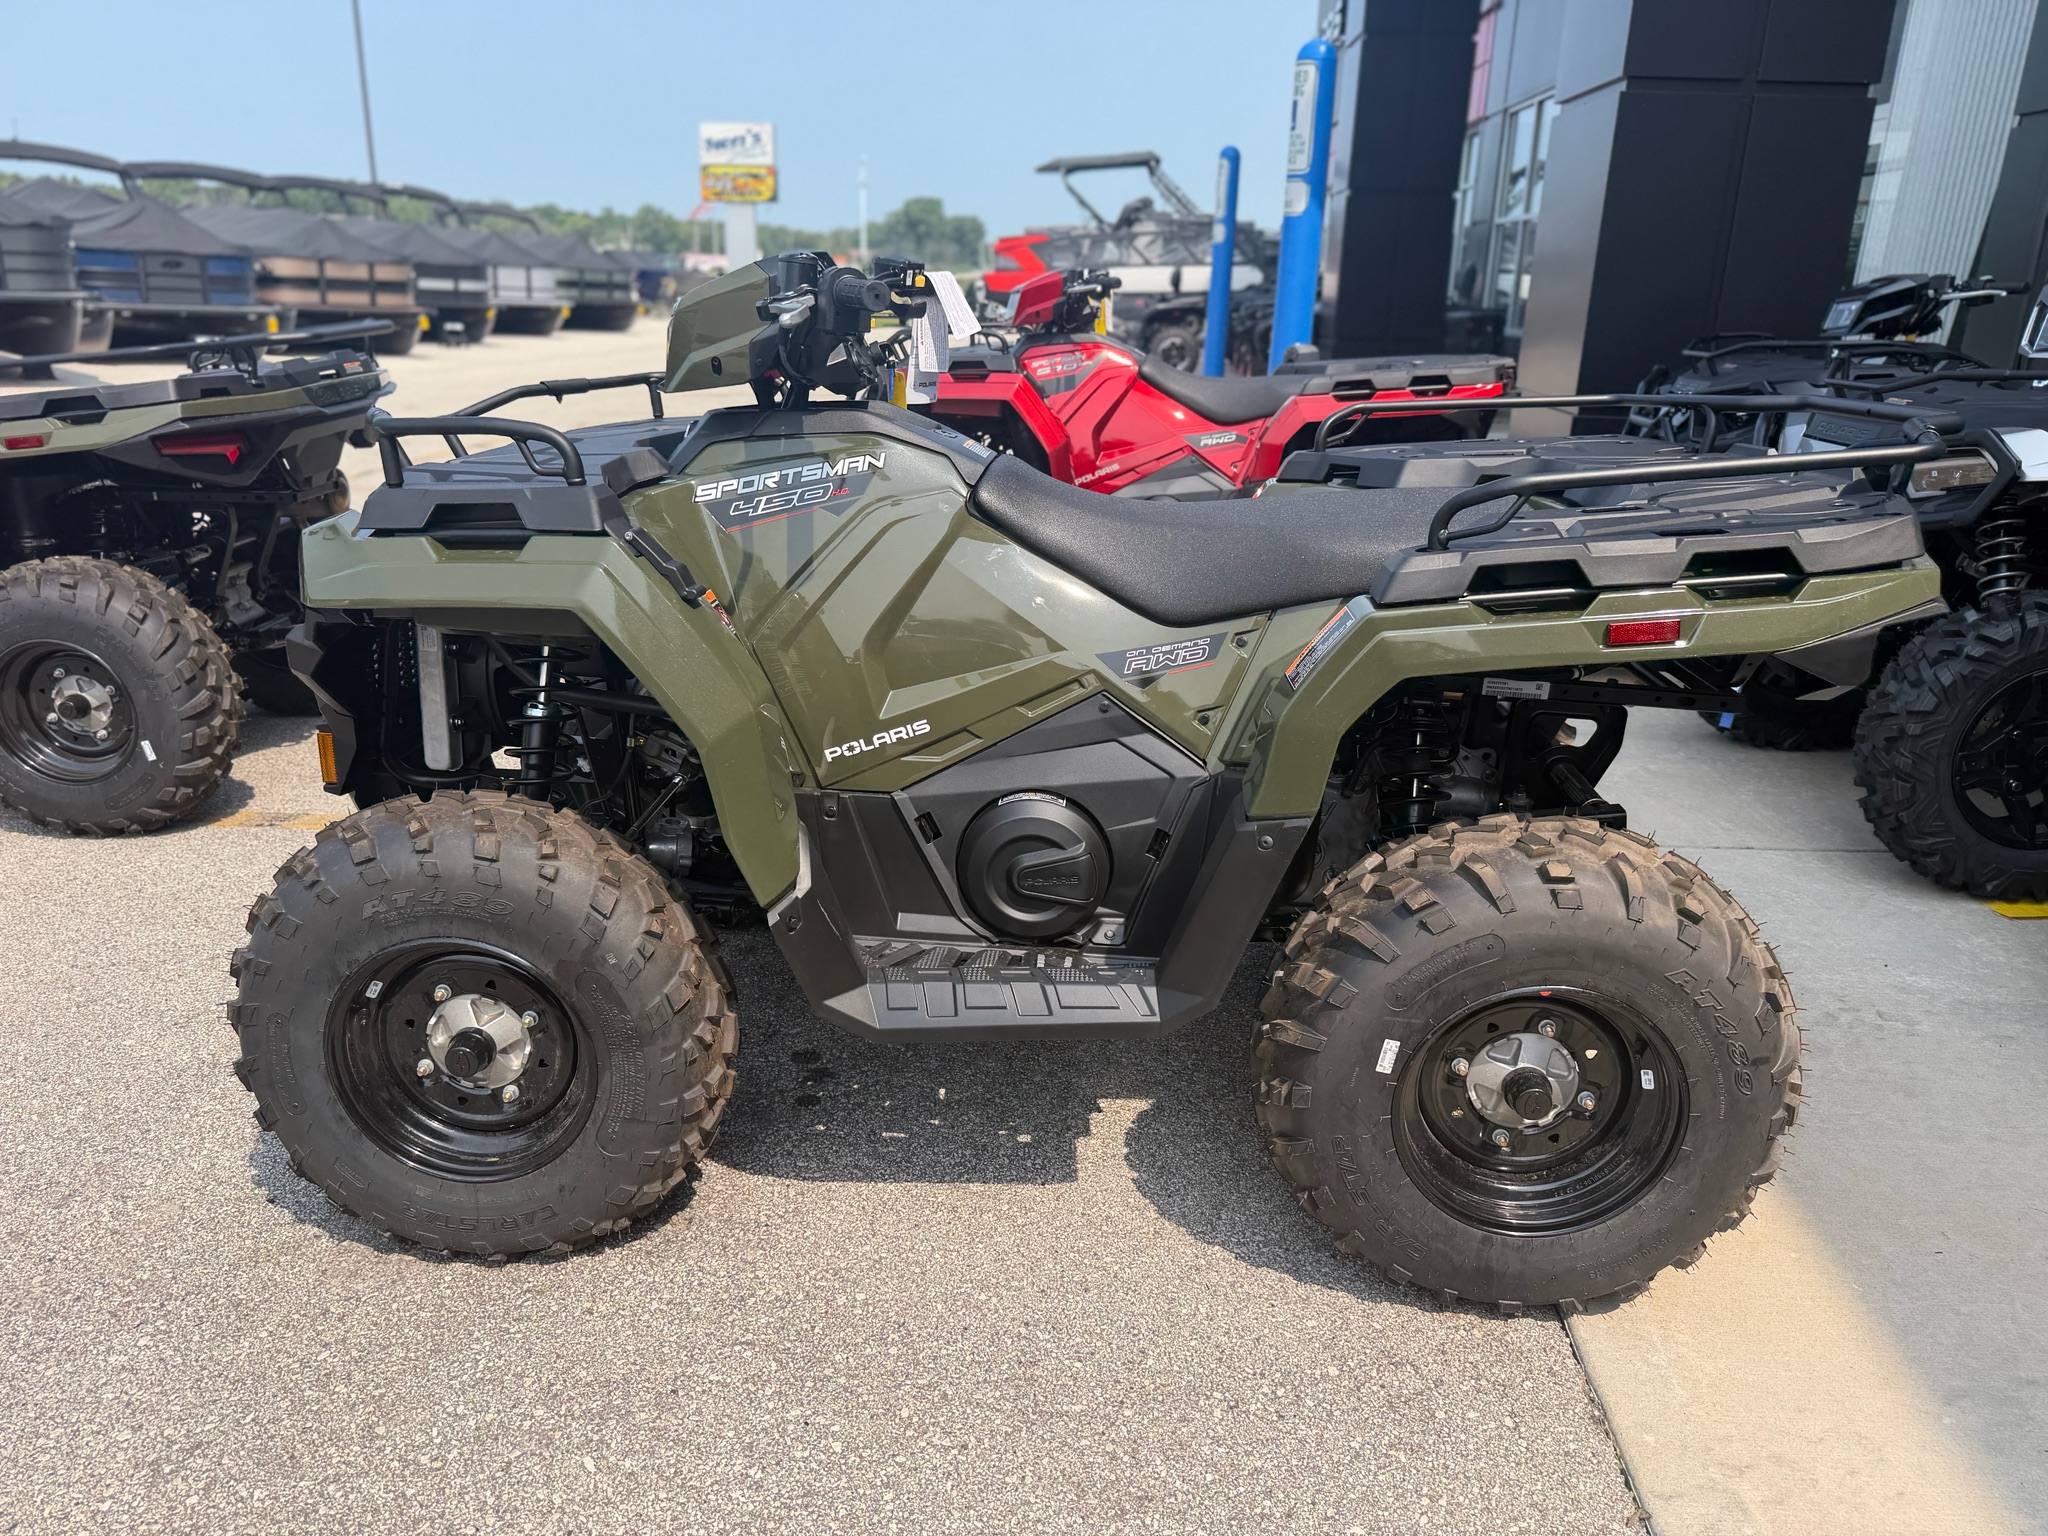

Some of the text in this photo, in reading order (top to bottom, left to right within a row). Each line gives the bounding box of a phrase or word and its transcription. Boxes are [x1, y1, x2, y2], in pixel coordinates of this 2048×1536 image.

[1036, 362, 1077, 375] 570
[1200, 434, 1237, 447] AWD
[694, 453, 886, 503] SPORTSMAN
[1074, 462, 1120, 486] POLARIS
[729, 482, 850, 516] 450 H.O.
[1124, 645, 1210, 674] AWD
[1126, 638, 1211, 658] ON DEMAND
[824, 719, 931, 762] POLARIS
[361, 889, 515, 920] AT489
[1664, 967, 1753, 1095] AT489
[1331, 1135, 1428, 1261] CARLSTAR
[400, 1200, 558, 1233] CARLSTAR
